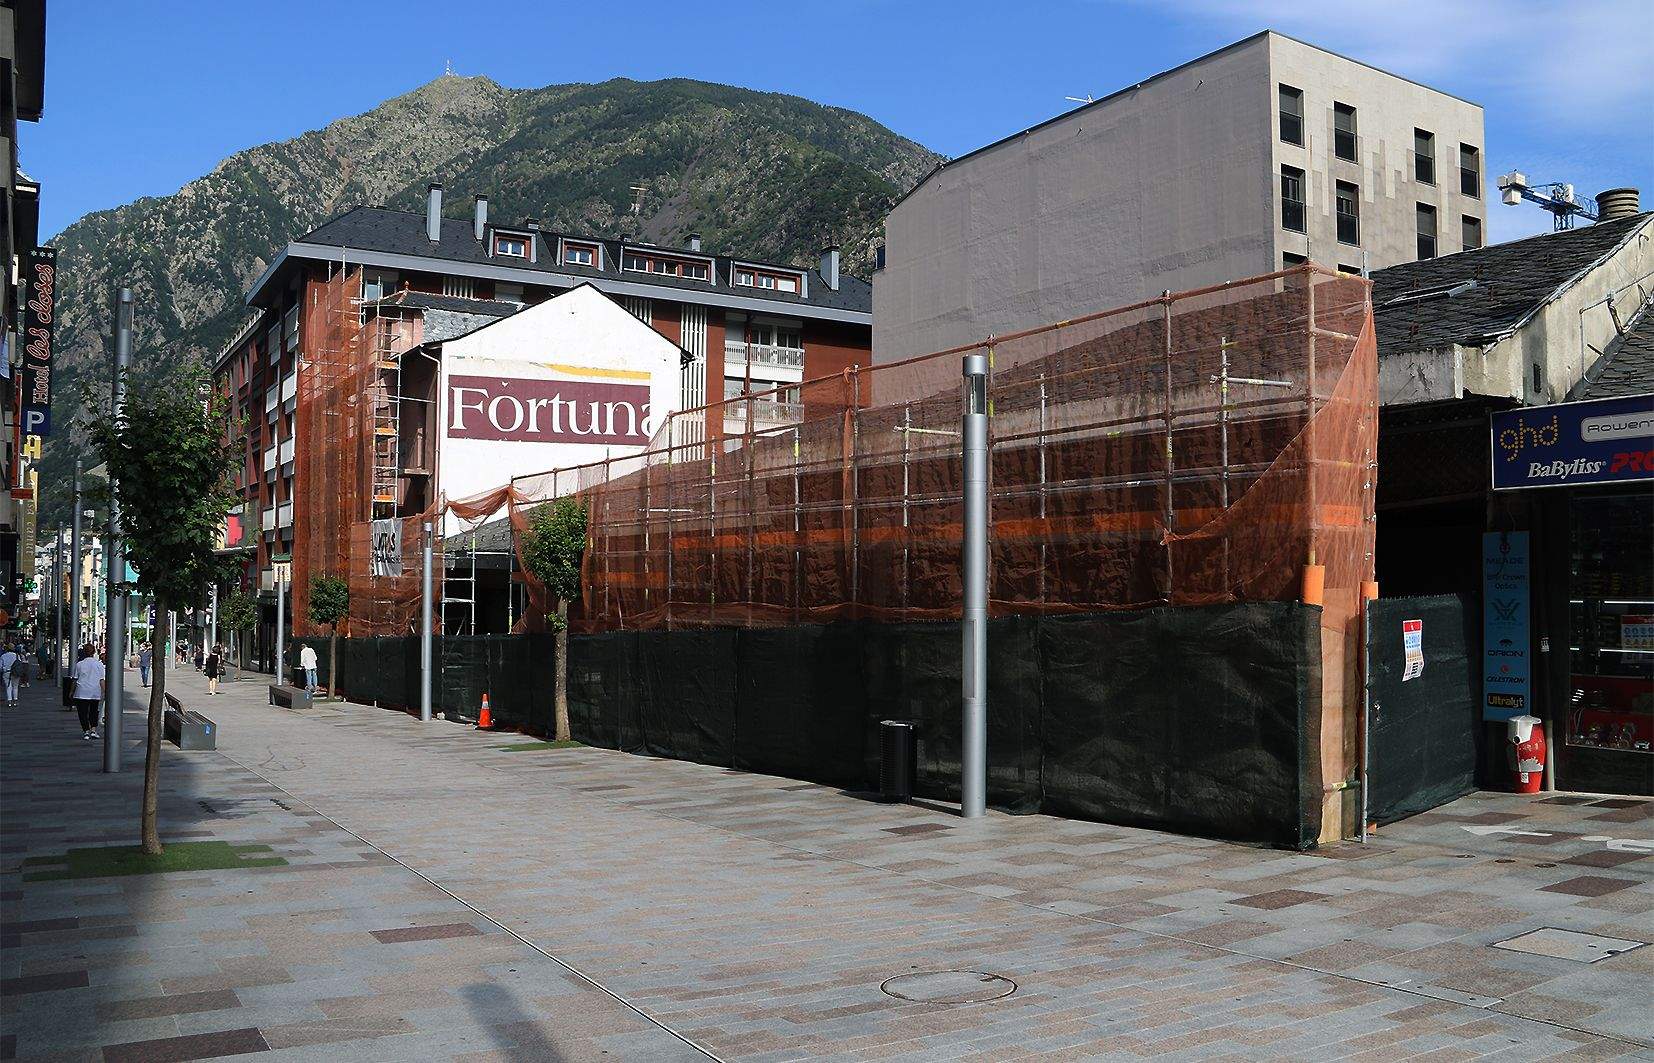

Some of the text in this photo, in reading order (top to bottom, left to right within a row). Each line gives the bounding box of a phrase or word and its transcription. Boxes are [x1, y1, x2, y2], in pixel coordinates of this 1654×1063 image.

[26, 263, 54, 404] Hotel les closes
[26, 410, 45, 432] P
[1499, 415, 1559, 462] ghd
